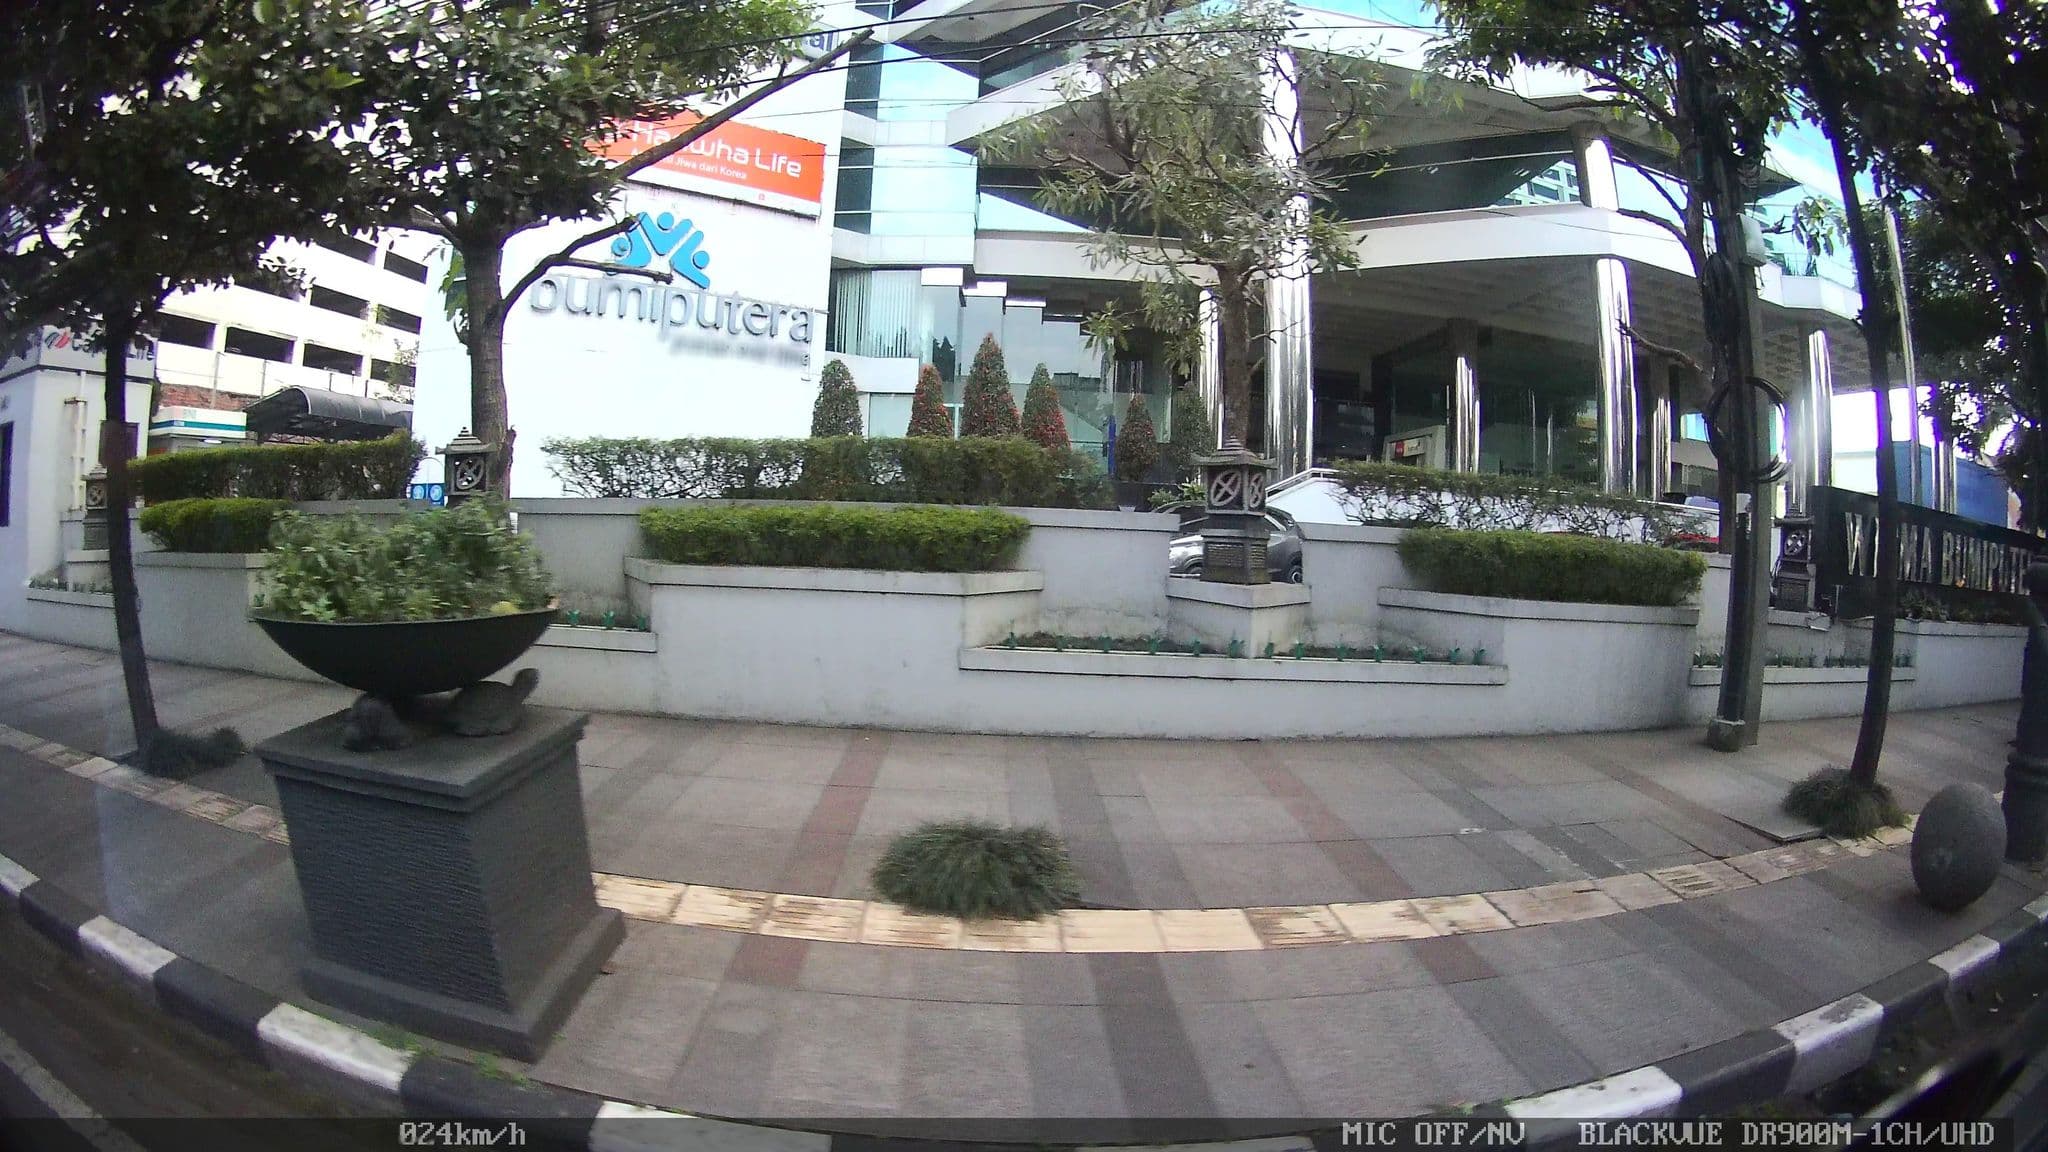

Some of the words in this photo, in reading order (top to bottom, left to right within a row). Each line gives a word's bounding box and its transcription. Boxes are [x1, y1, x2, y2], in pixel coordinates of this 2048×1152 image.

[631, 121, 749, 166] Hawha
[755, 148, 802, 179] Life
[698, 162, 718, 173] dari
[719, 165, 748, 180] Korea
[1845, 511, 1932, 583] WIMA
